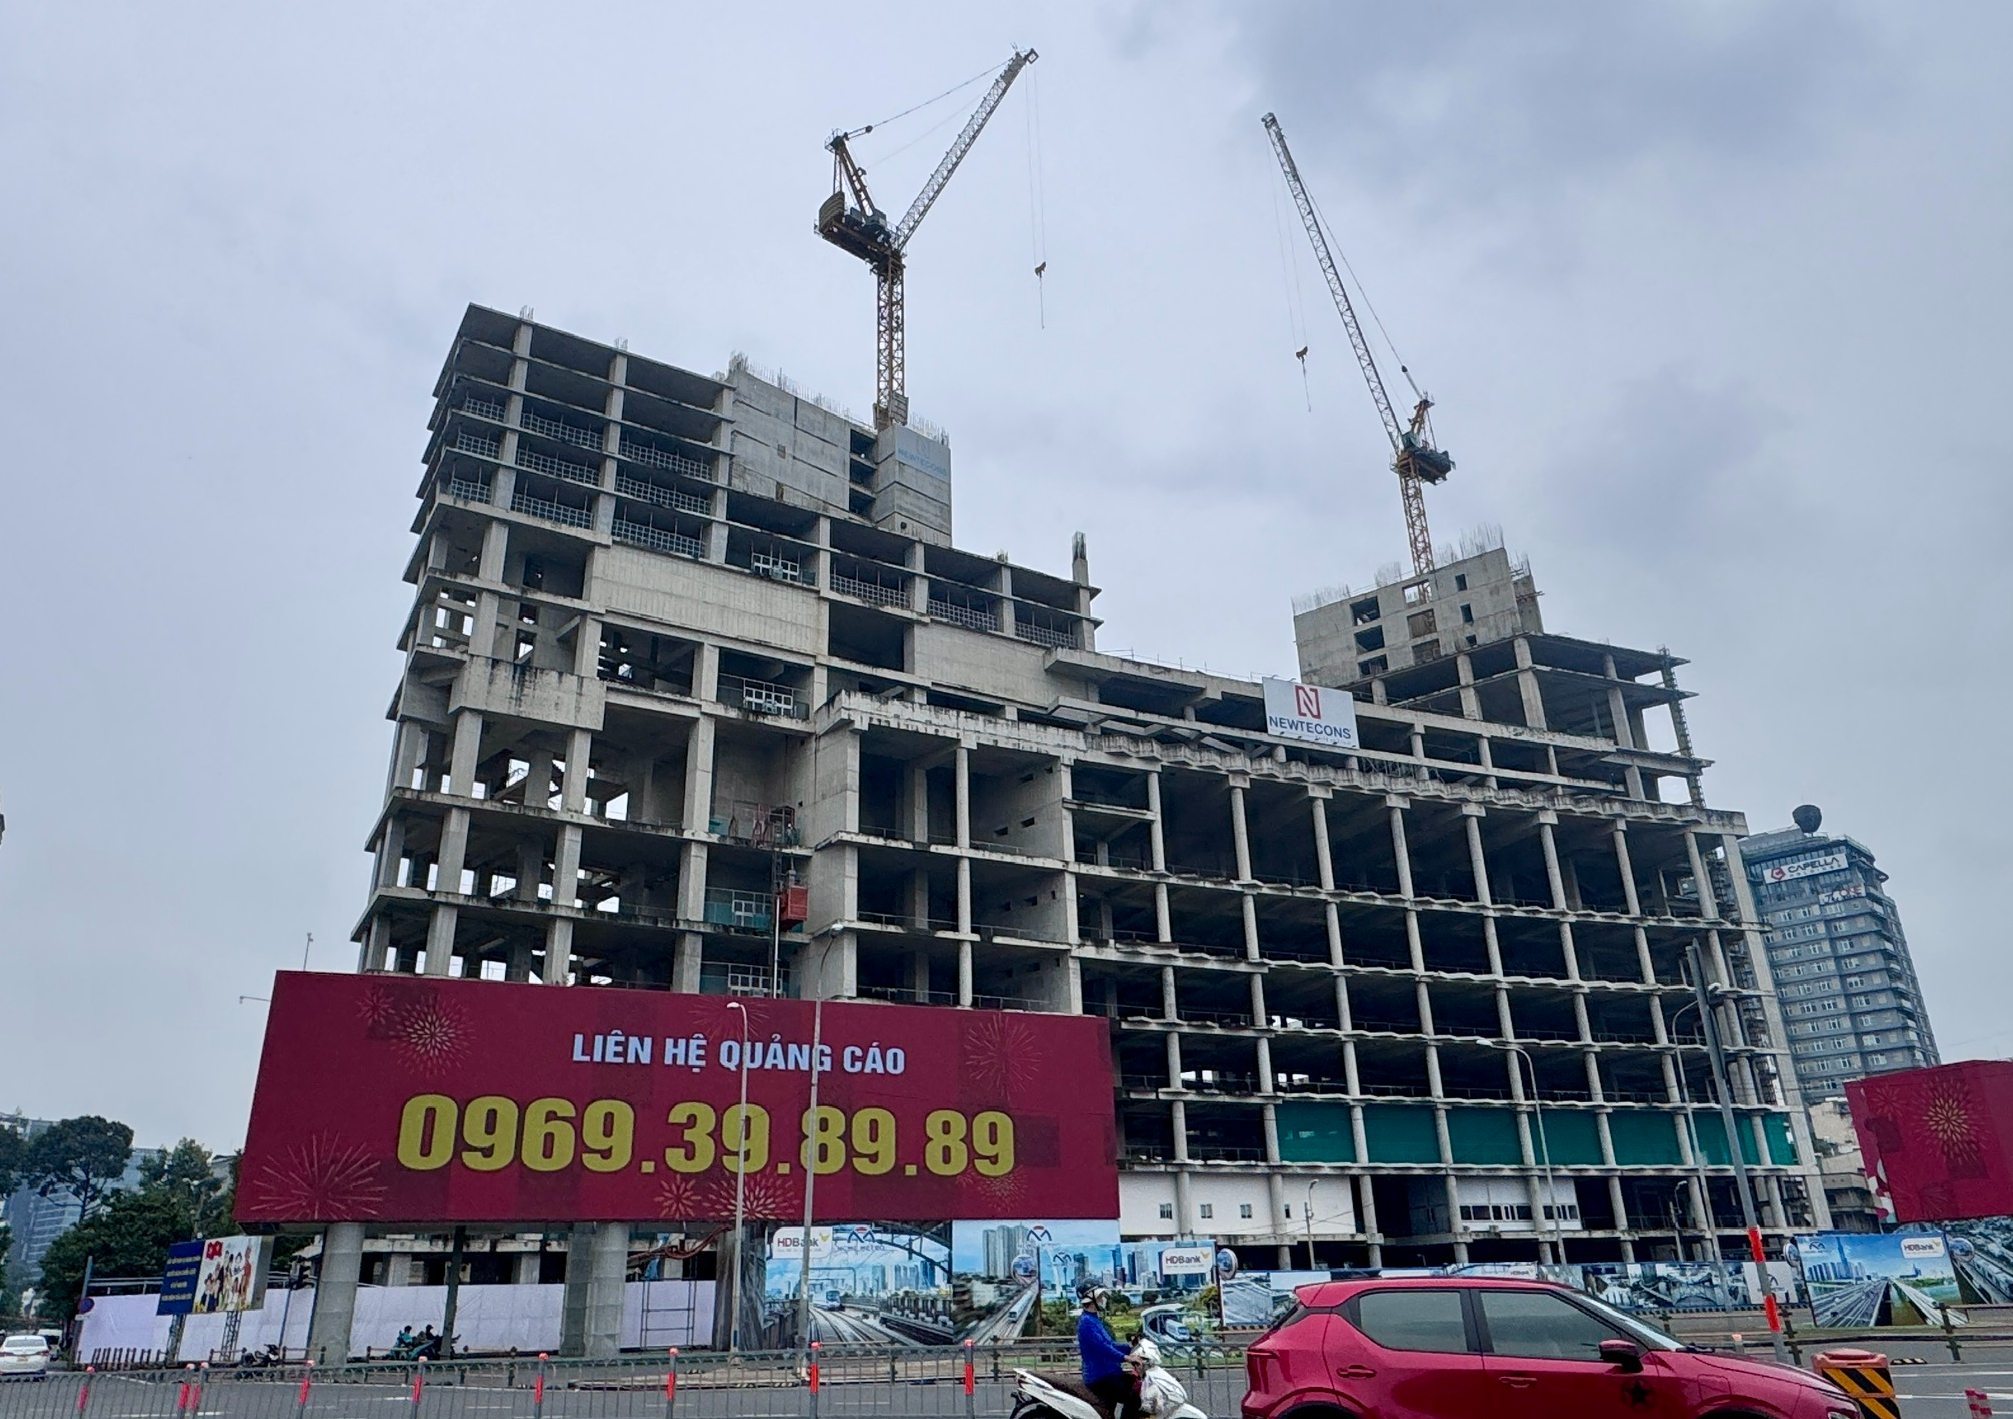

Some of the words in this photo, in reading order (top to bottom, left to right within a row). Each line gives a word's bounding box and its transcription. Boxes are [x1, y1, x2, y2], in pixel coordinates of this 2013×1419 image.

[1268, 715, 1352, 740] NEWTECONS
[1787, 856, 1839, 874] CAPELLA
[572, 1029, 652, 1064] LIÊN
[664, 1033, 707, 1073] HỆ
[719, 1034, 832, 1072] QUẢNG
[843, 1041, 905, 1075] CÁO
[397, 1094, 1015, 1177] 0969.39.89.89
[1165, 1255, 1201, 1264] HDBank
